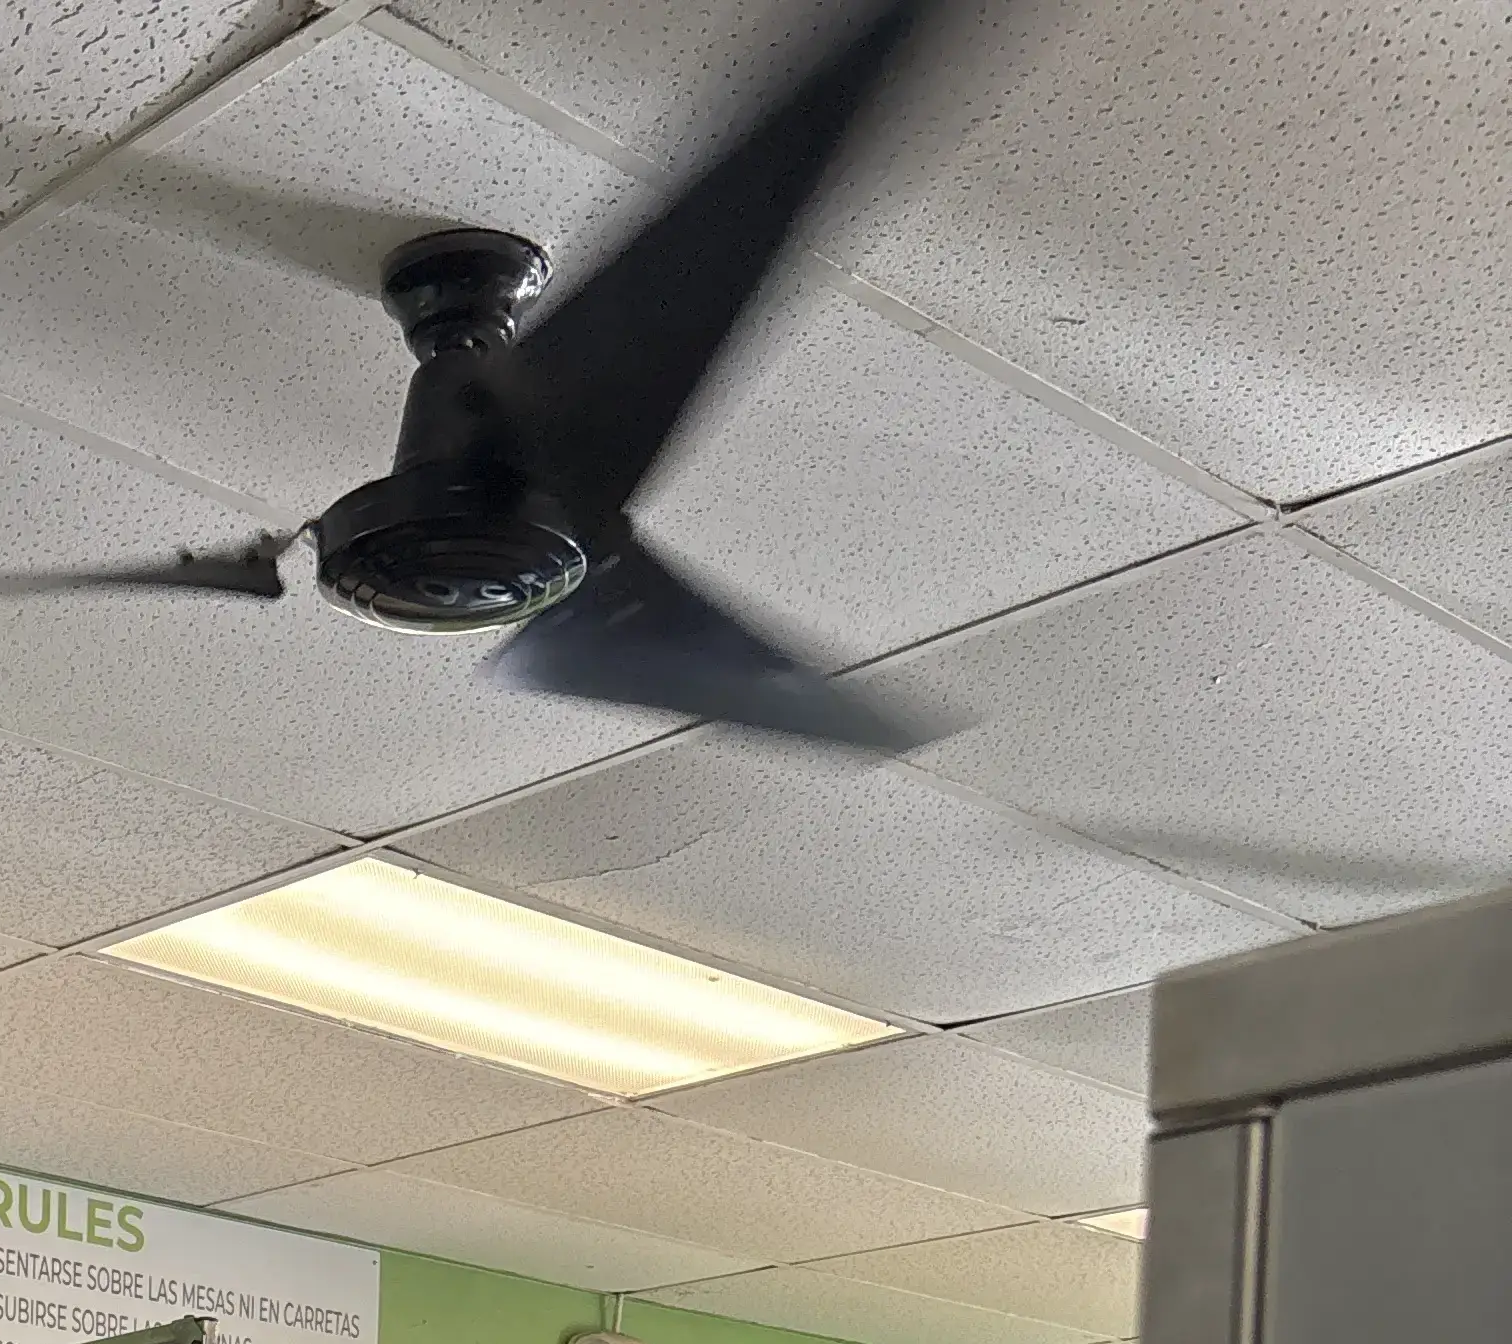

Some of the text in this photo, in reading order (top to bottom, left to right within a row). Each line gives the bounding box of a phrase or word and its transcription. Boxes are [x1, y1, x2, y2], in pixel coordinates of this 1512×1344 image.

[71, 1306, 129, 1337] SOBRE
[86, 1264, 144, 1300] SOBRE
[148, 1275, 178, 1306] LAS
[181, 1282, 235, 1317] MESAS
[238, 1293, 255, 1320] NI
[258, 1296, 280, 1325] EN
[283, 1301, 360, 1339] CARRETAS
